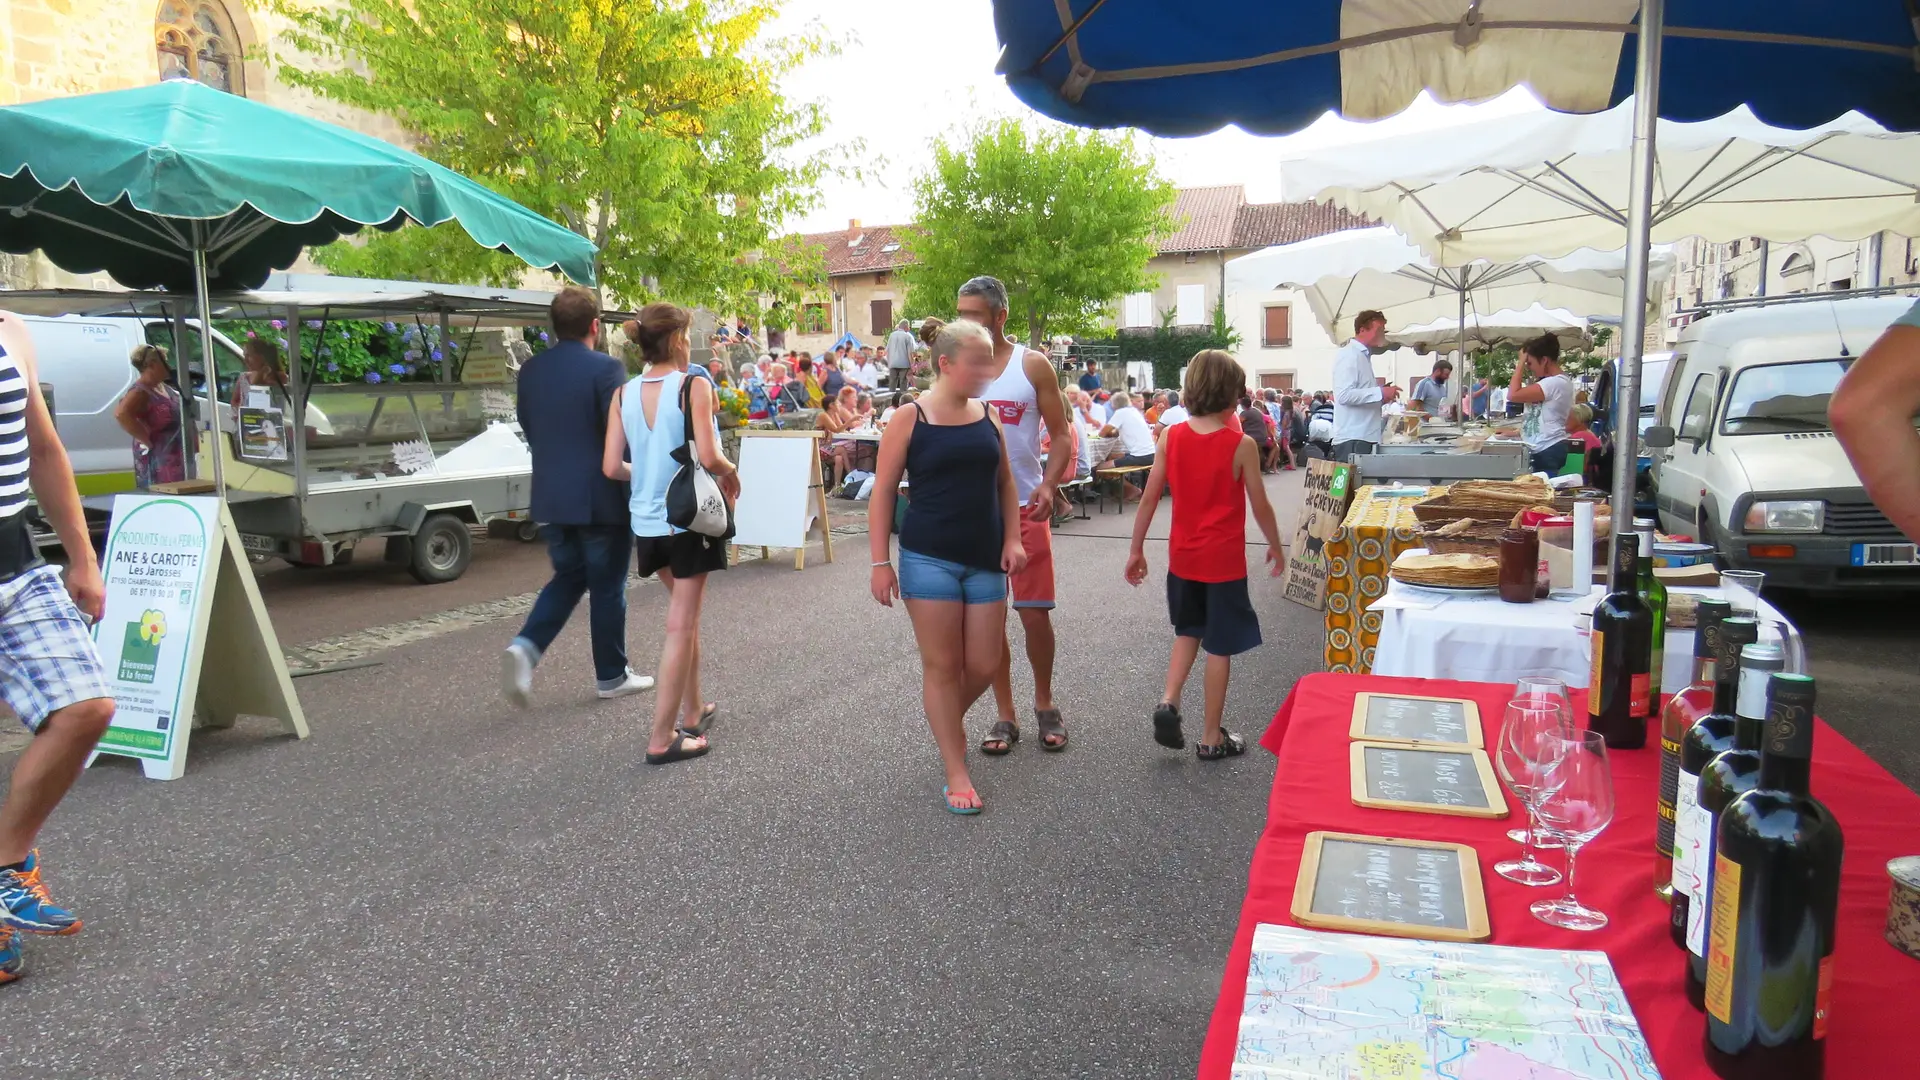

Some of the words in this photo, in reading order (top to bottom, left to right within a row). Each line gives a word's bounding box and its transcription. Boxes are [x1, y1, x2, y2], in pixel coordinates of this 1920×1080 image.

[118, 531, 159, 546] PRODUITS
[115, 550, 139, 564] ANE
[141, 551, 149, 565] &
[150, 552, 198, 567] CAROTTE
[128, 564, 144, 576] Les
[145, 565, 181, 578] Jarosses
[122, 659, 155, 671] bienvenue
[126, 671, 134, 681] la
[135, 671, 154, 682] ferme
